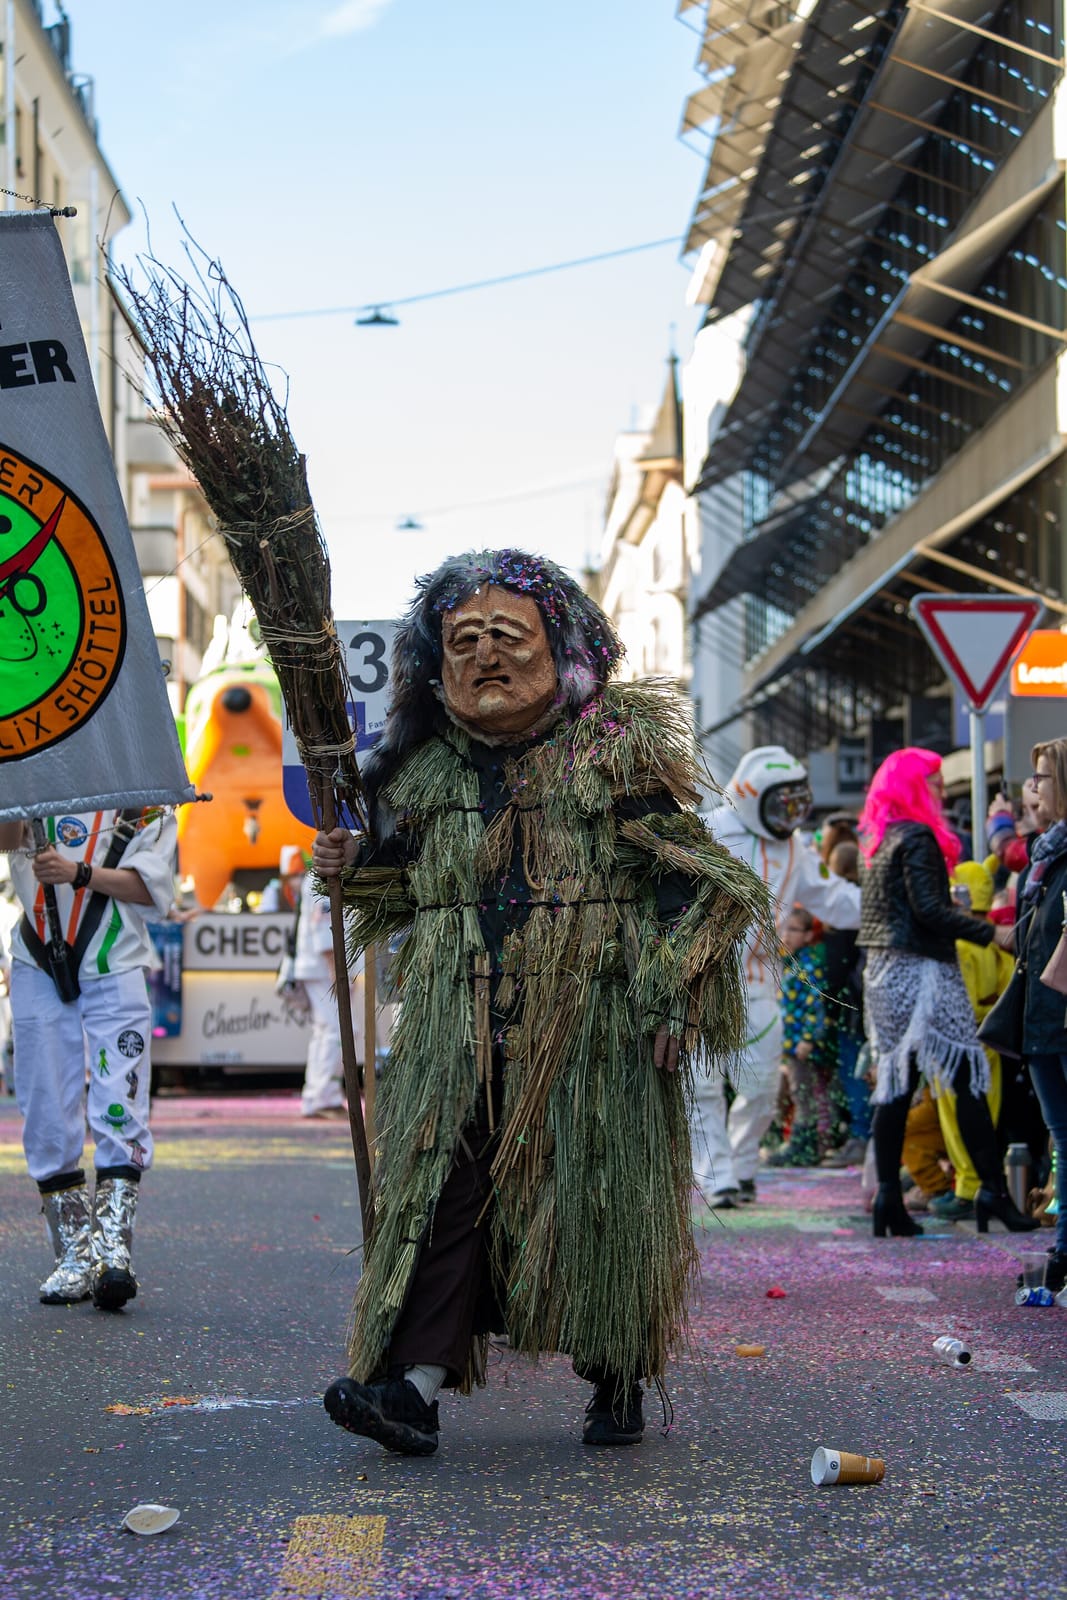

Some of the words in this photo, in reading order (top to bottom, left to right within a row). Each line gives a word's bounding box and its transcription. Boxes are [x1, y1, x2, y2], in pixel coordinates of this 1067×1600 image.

[0, 339, 76, 390] ER
[0, 457, 43, 506] ER
[54, 577, 117, 721] SHÖTTEL
[350, 631, 388, 693] 3
